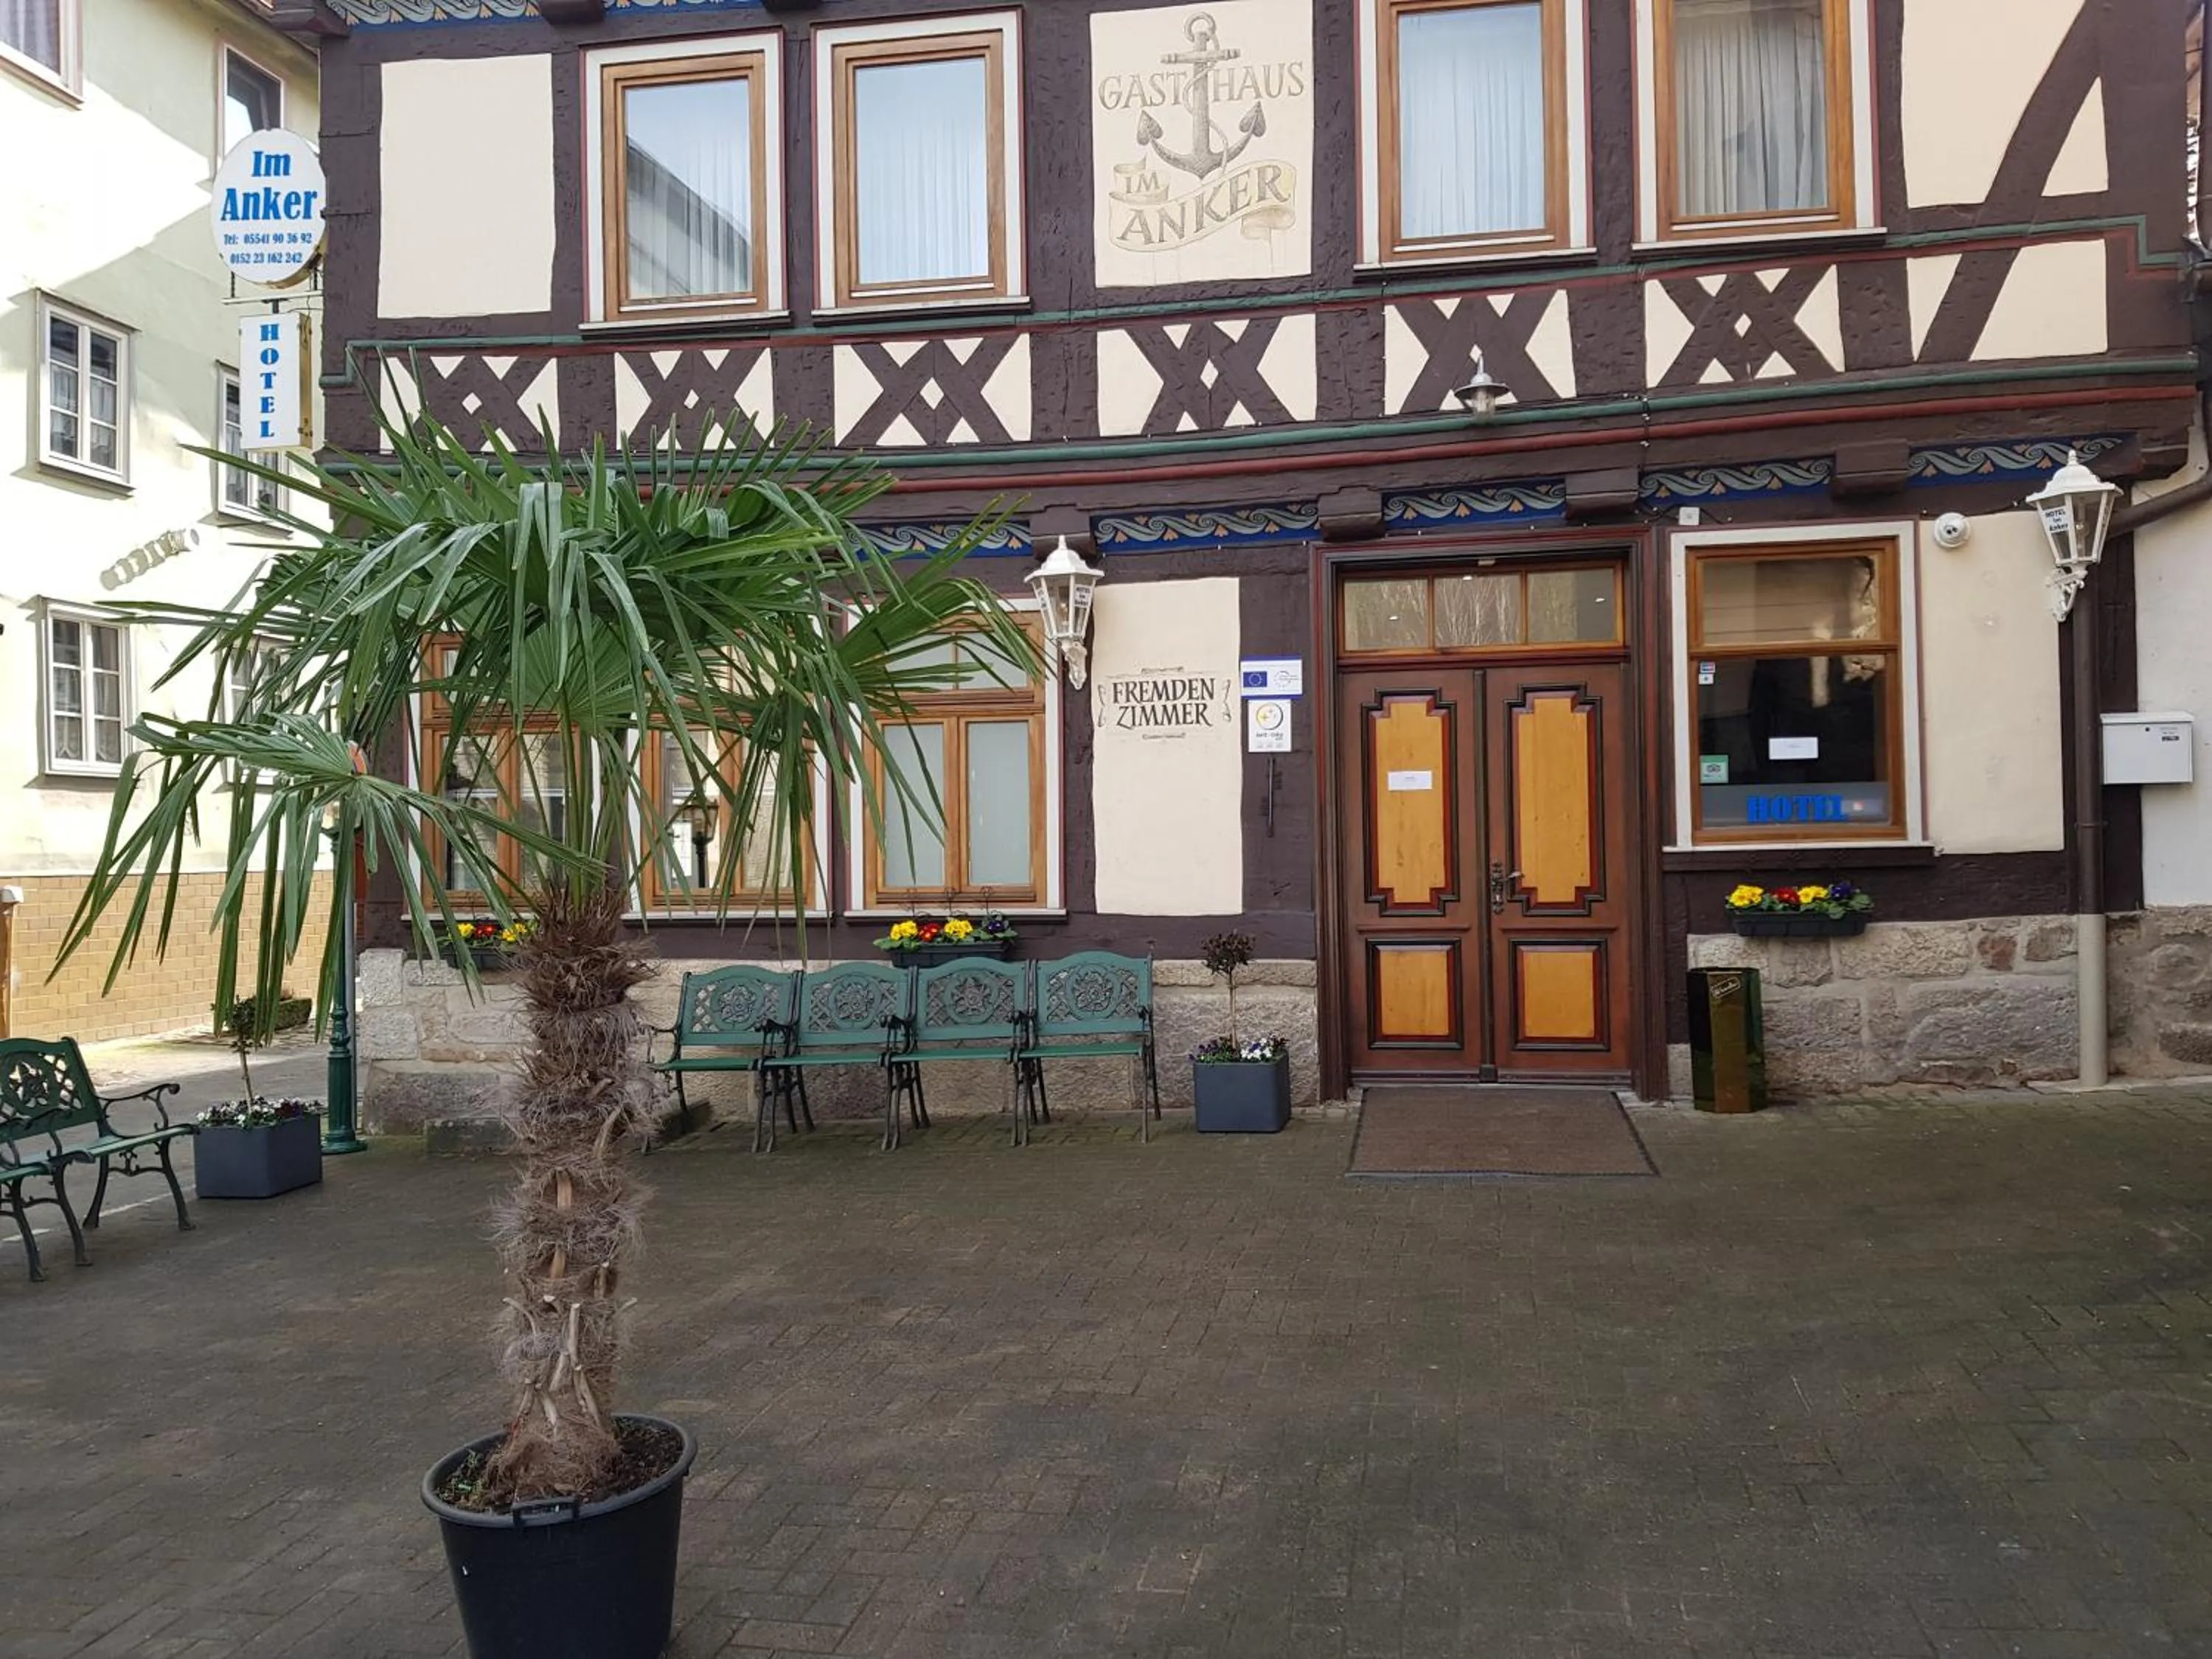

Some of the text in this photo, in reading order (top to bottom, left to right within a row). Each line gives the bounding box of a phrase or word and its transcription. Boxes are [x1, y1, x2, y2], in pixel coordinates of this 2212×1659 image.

[251, 150, 291, 178] Im
[1124, 171, 1161, 195] IM
[220, 187, 318, 221] Anker
[1116, 164, 1291, 245] ANKER
[223, 233, 240, 245] Tel:
[243, 232, 270, 244] 05541
[272, 232, 285, 244] 90
[300, 232, 312, 244] 92
[229, 252, 251, 264] 0152
[253, 252, 265, 264] 23
[285, 251, 303, 263] 242
[260, 324, 280, 438] HOTEL
[1112, 677, 1216, 704] FREMDEN
[1116, 702, 1214, 730] ZIMMER
[1747, 794, 1849, 825] HOTEL
